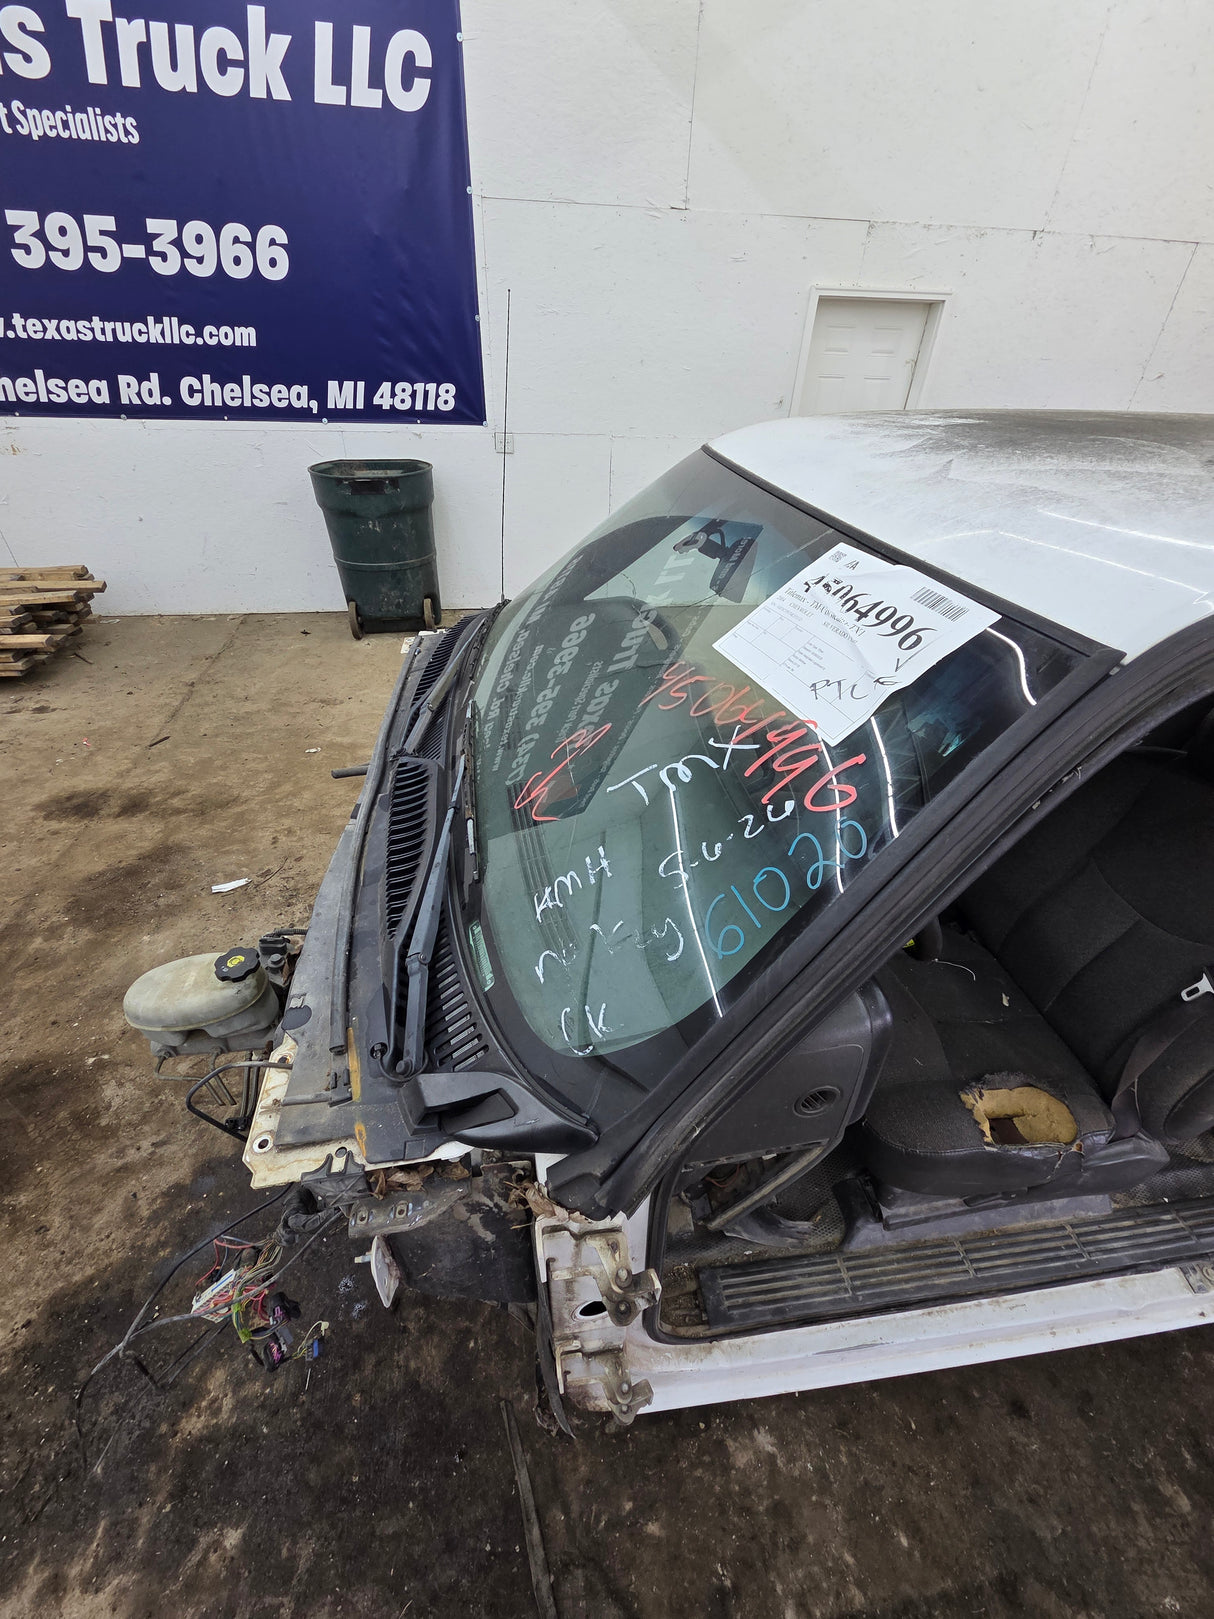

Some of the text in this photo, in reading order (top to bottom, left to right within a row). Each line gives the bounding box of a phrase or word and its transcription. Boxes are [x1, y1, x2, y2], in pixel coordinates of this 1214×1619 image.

[0, 0, 433, 112] s Truck LLC
[11, 99, 140, 144] Specialists
[4, 209, 290, 281] 395-3966
[0, 312, 257, 347] .texastruckllc.com
[118, 372, 172, 405] Rd.
[180, 374, 318, 414] Chelsea,
[327, 380, 365, 409] MI
[373, 381, 456, 411] 48118
[705, 816, 868, 960] 61020
